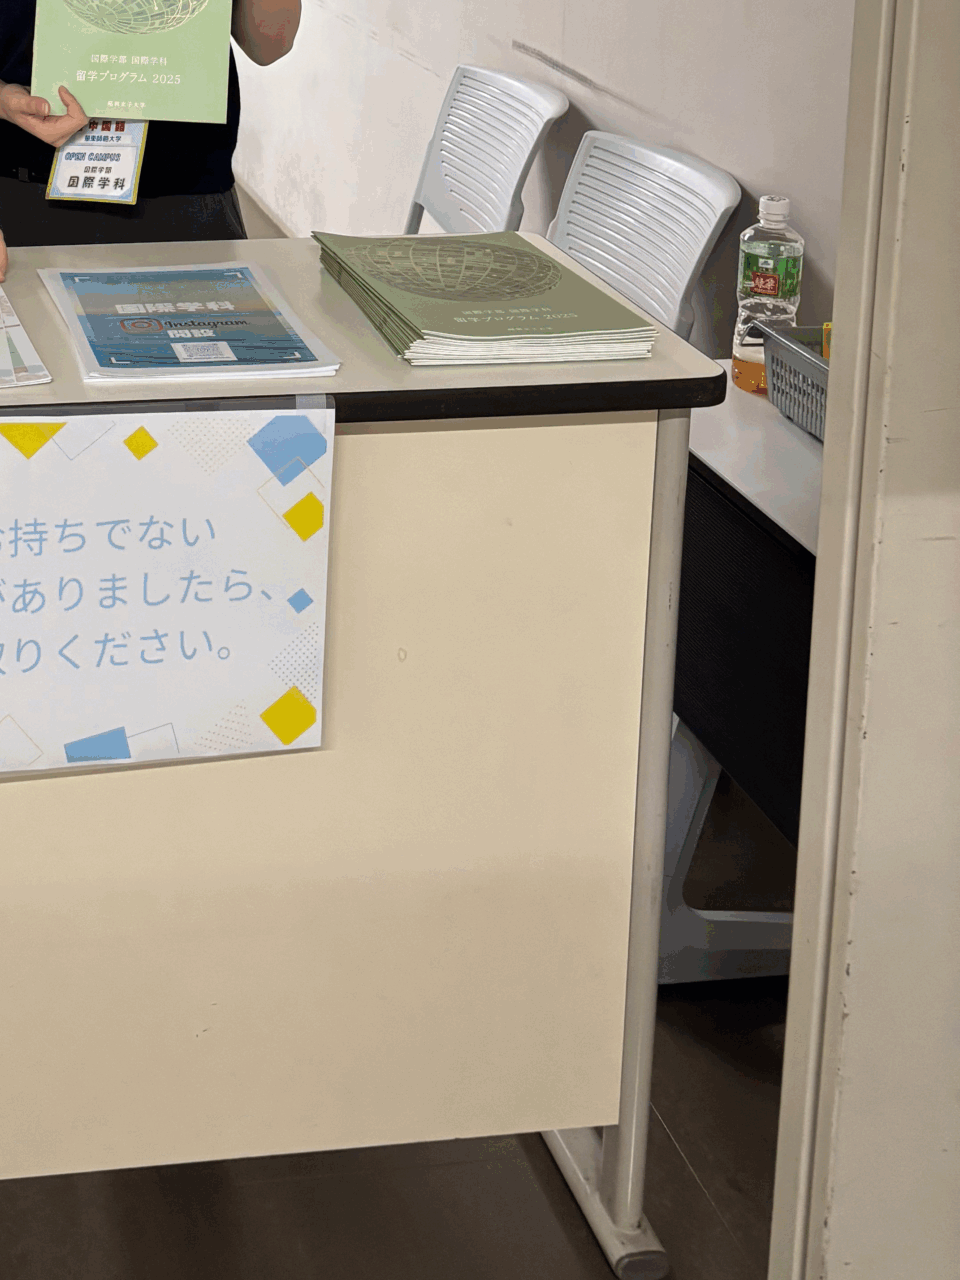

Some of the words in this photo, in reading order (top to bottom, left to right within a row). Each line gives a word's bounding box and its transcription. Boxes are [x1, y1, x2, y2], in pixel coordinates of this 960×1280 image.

[91, 54, 127, 64] 国際学部
[131, 56, 167, 66] 国際学科
[76, 69, 147, 83] 留学プログラム
[152, 73, 181, 85] 2025
[64, 152, 86, 162] OPEN
[87, 152, 121, 162] CAMPUS
[67, 175, 126, 191] 国際学科
[164, 320, 248, 329] Instagram
